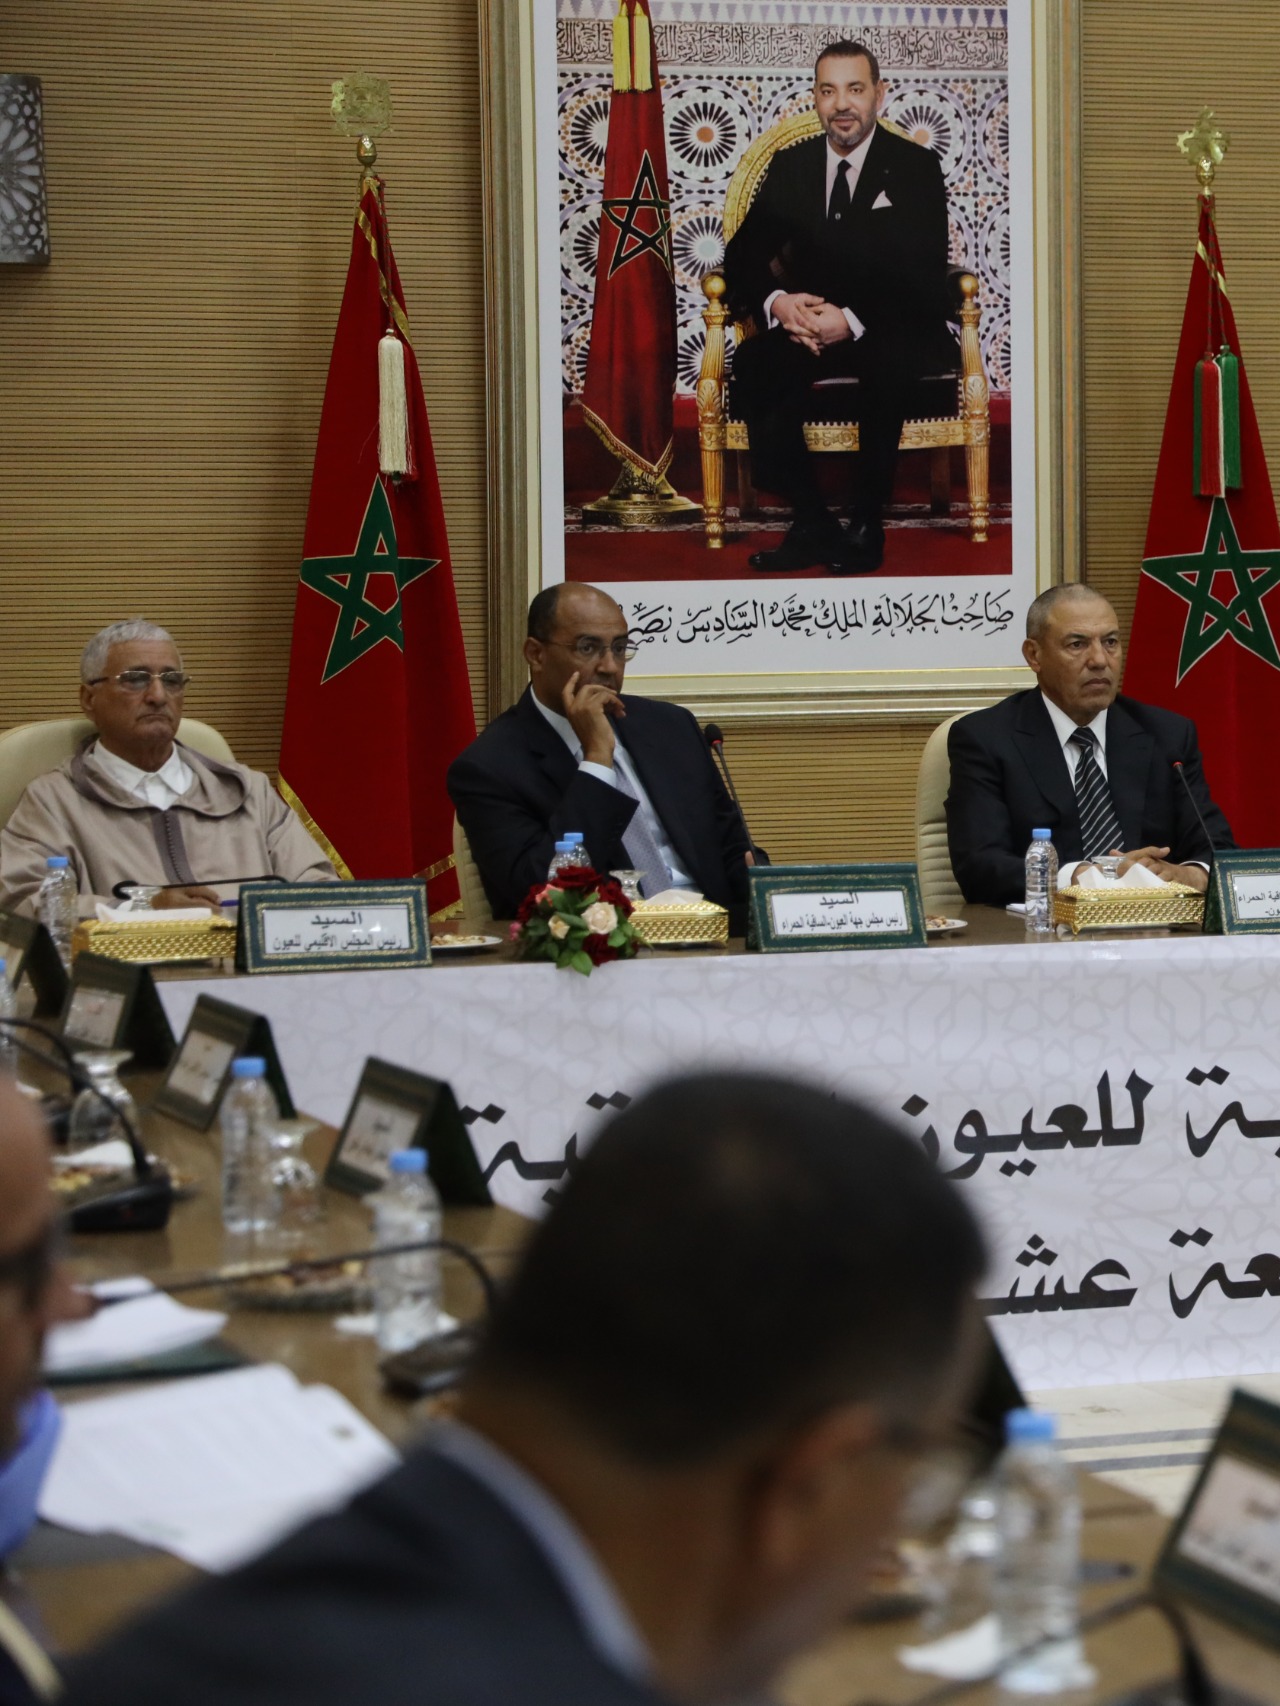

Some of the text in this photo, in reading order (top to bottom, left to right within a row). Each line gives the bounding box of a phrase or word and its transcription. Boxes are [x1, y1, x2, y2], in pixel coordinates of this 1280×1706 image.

[819, 892, 859, 909] السيد
[1238, 892, 1266, 903] الحمراء
[311, 911, 362, 929] السيد
[850, 912, 863, 928] جهة
[866, 912, 884, 928] مجلس
[273, 934, 301, 951] للعيون
[341, 933, 373, 949] المجلس
[377, 934, 402, 950] رئيس
